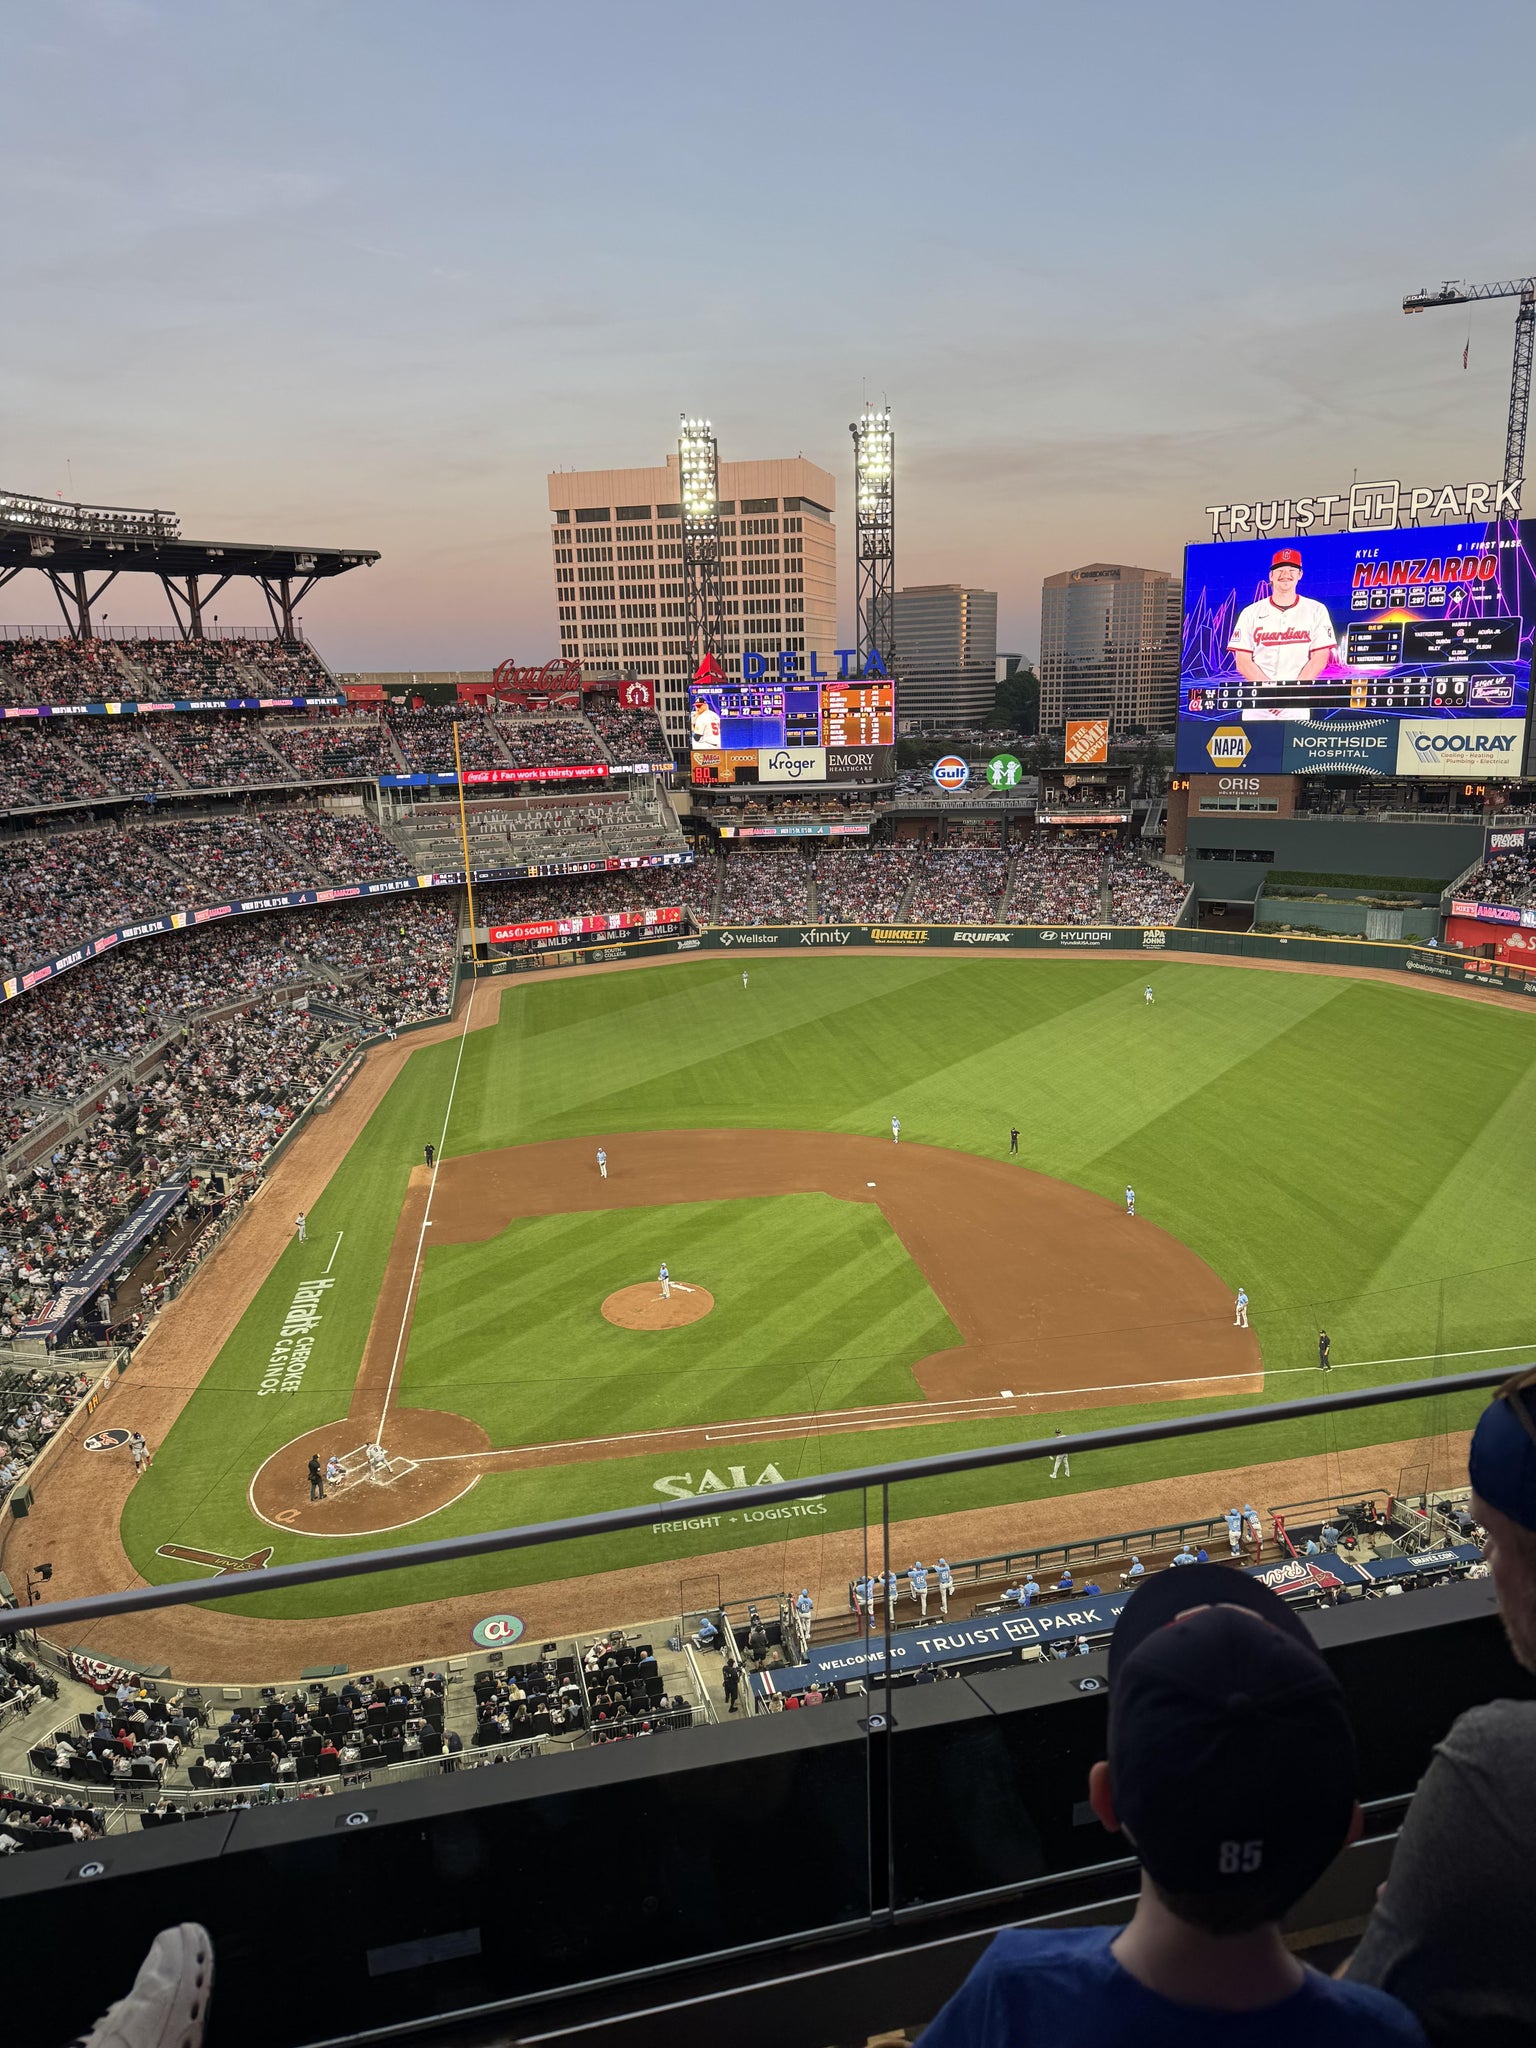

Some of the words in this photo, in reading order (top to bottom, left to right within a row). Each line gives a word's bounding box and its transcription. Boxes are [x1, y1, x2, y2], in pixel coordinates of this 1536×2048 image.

[1206, 495, 1340, 534] TRUIST
[1409, 479, 1526, 521] PARK
[1470, 542, 1496, 550] FIRST
[1499, 540, 1522, 548] BASE
[1355, 548, 1380, 558] KYLE
[1352, 554, 1498, 589] MANZARDO
[742, 649, 887, 679] DELTA
[1437, 683, 1446, 694] 0
[1454, 682, 1464, 694] 0
[1070, 726, 1088, 743] THE
[1066, 722, 1108, 763] HOME
[1081, 736, 1108, 763] DEPOT
[1214, 739, 1244, 755] NAPA
[1293, 737, 1388, 748] NORTHSIDE
[1415, 735, 1517, 751] COOLRAY
[769, 751, 815, 778] Kroger
[829, 754, 874, 766] EMORY
[548, 769, 571, 778] thirsty
[696, 768, 710, 778] 80
[936, 768, 965, 778] Gulf
[1219, 778, 1260, 790] ORIS
[1465, 785, 1485, 796] 0:14
[480, 823, 516, 834] HANK
[526, 818, 572, 830] AARON
[1478, 906, 1520, 921] AMAZING
[524, 926, 553, 936] SOUTH
[654, 925, 678, 934] MLB+
[800, 928, 850, 945] xfinity
[871, 928, 927, 940] QUIKRETE
[953, 931, 1010, 943] EQUIFAX
[1061, 931, 1111, 940] HYUNDAI
[736, 934, 778, 944] Wellstar
[280, 1278, 335, 1337] Harrah's
[257, 1339, 293, 1396] CASINOS
[280, 1337, 315, 1393] CHEROKEE
[653, 1464, 786, 1502] SAIA
[653, 1516, 722, 1534] FREIGHT
[744, 1503, 827, 1523] LOGISTICS
[1412, 1552, 1454, 1564] BRAVES.COM
[818, 1651, 886, 1671] WELCOME
[890, 1647, 906, 1657] TO
[916, 1627, 999, 1653] TRUIST
[1038, 1609, 1102, 1631] PARK
[1220, 1840, 1263, 1873] 85
